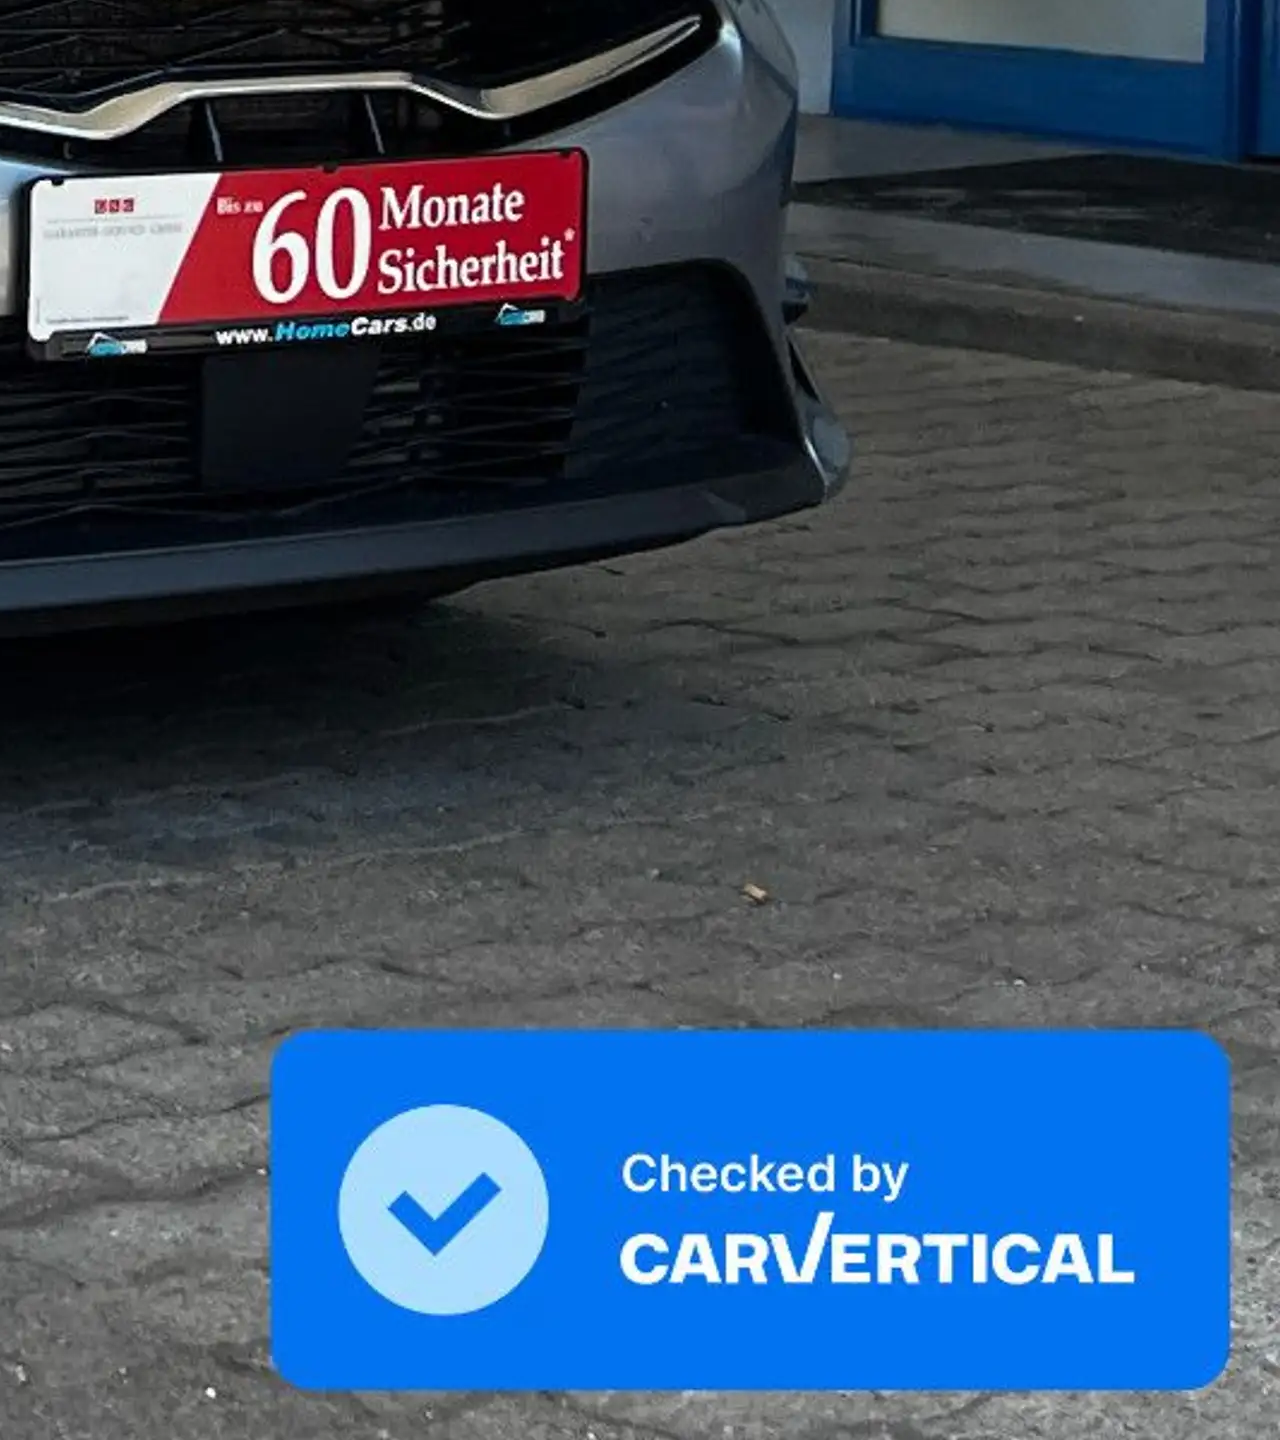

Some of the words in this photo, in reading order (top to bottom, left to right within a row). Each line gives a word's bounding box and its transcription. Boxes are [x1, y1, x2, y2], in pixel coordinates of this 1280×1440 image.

[379, 182, 524, 231] Monate
[252, 186, 372, 304] 60
[215, 312, 437, 346] www.HomeCars.de
